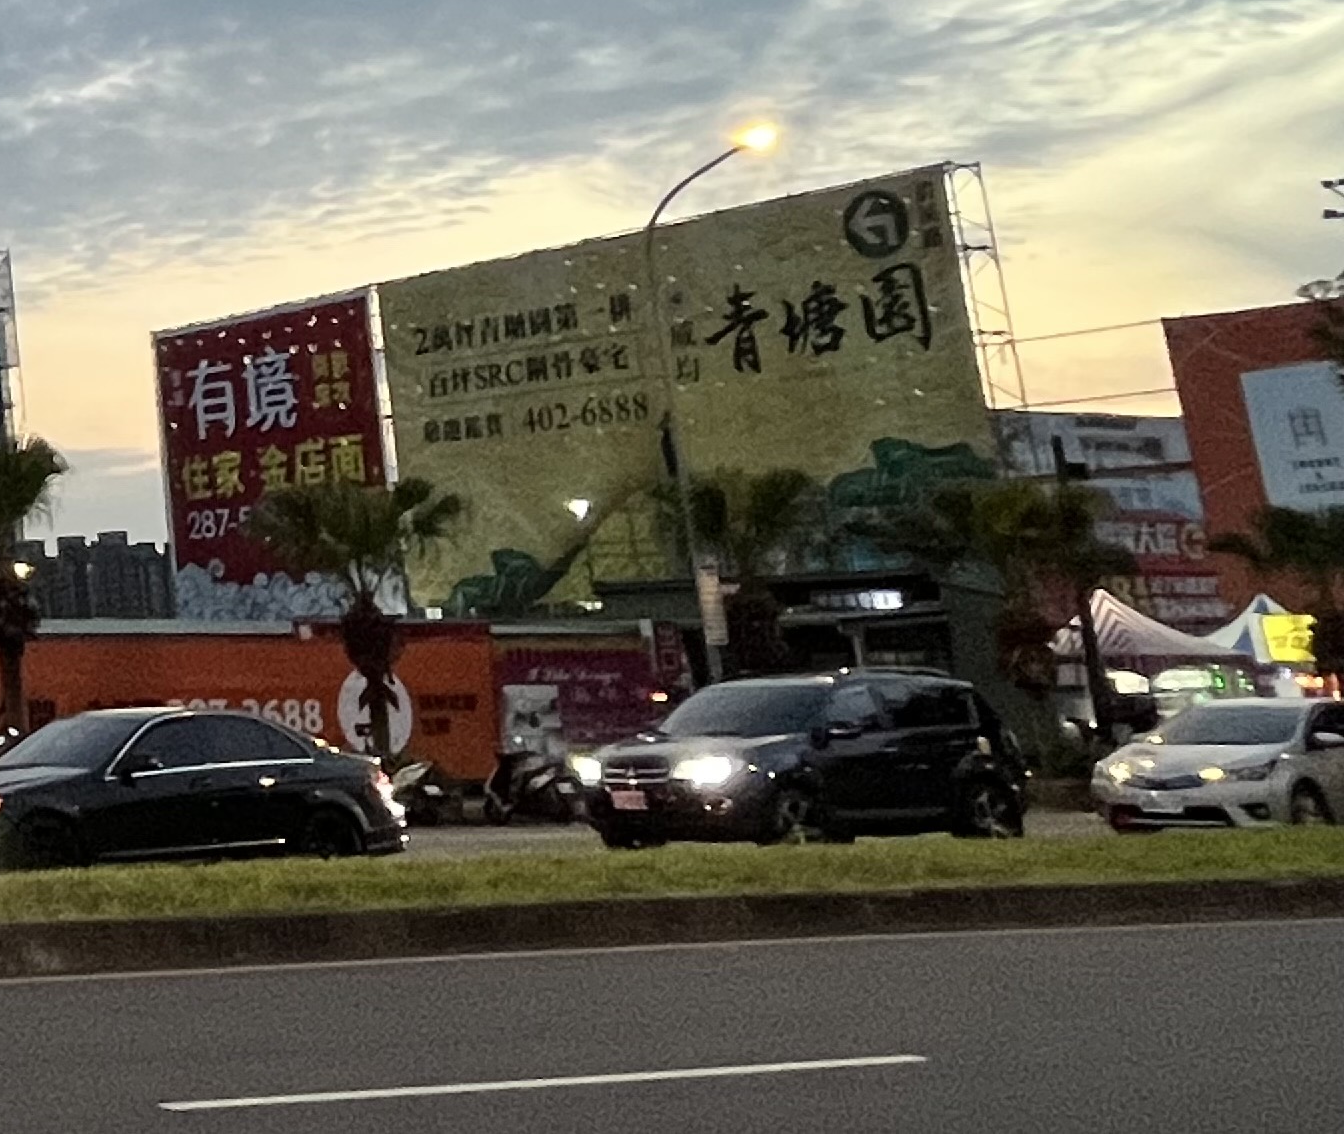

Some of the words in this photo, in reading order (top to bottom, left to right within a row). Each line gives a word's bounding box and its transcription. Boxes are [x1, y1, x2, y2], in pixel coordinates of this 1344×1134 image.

[706, 263, 931, 374] 青塘園
[186, 346, 299, 440] 有境
[523, 391, 649, 434] 402-6888
